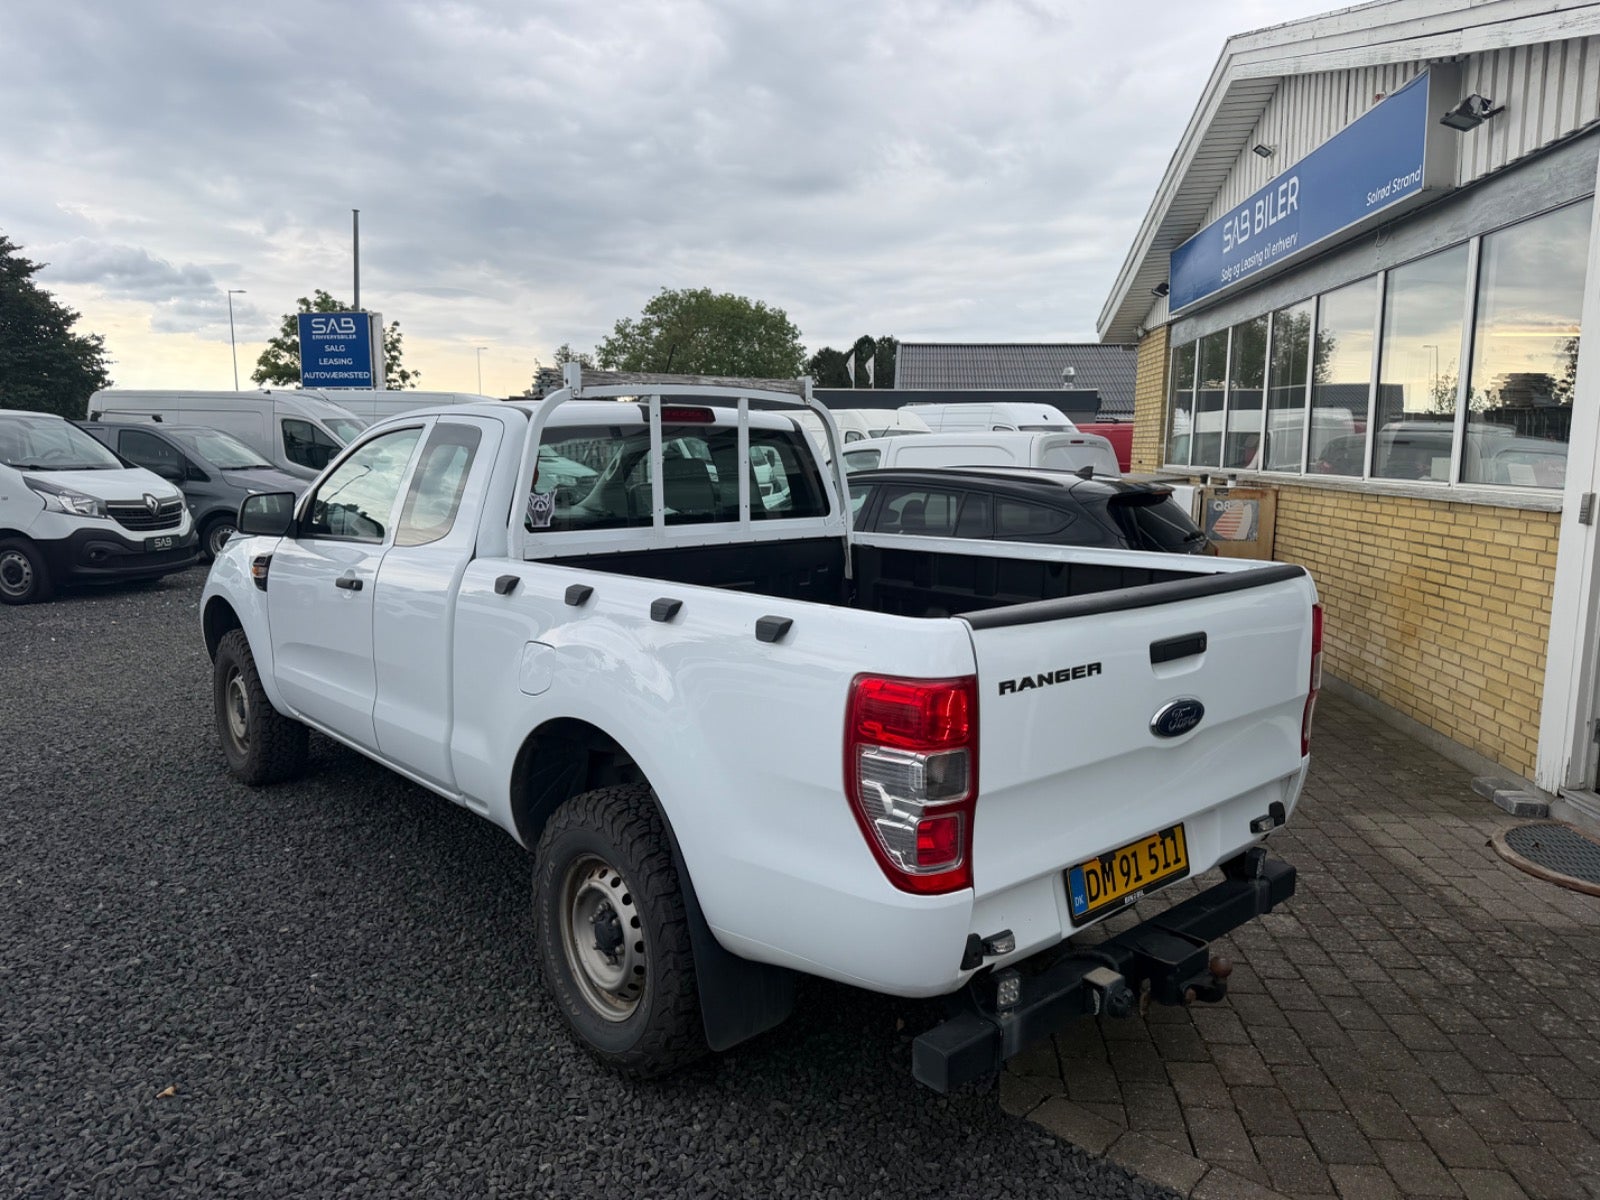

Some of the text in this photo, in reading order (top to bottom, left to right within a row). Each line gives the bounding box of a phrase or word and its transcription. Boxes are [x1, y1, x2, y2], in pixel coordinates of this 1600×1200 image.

[1366, 164, 1422, 207] Solrød Strand
[1223, 176, 1300, 254] SAB BILER
[1221, 265, 1232, 282] Salg
[1233, 263, 1240, 278] og
[1241, 250, 1264, 272] Leasing
[1271, 232, 1298, 256] erhverv
[311, 317, 356, 334] SAB
[324, 344, 346, 352] SALG
[318, 357, 353, 366] LEASING
[303, 371, 370, 380] AUTOVÆRKSTED
[1213, 500, 1231, 512] Q8
[998, 662, 1102, 696] RANGER
[1085, 836, 1182, 903] DM 91 511
[1074, 895, 1084, 907] DK
